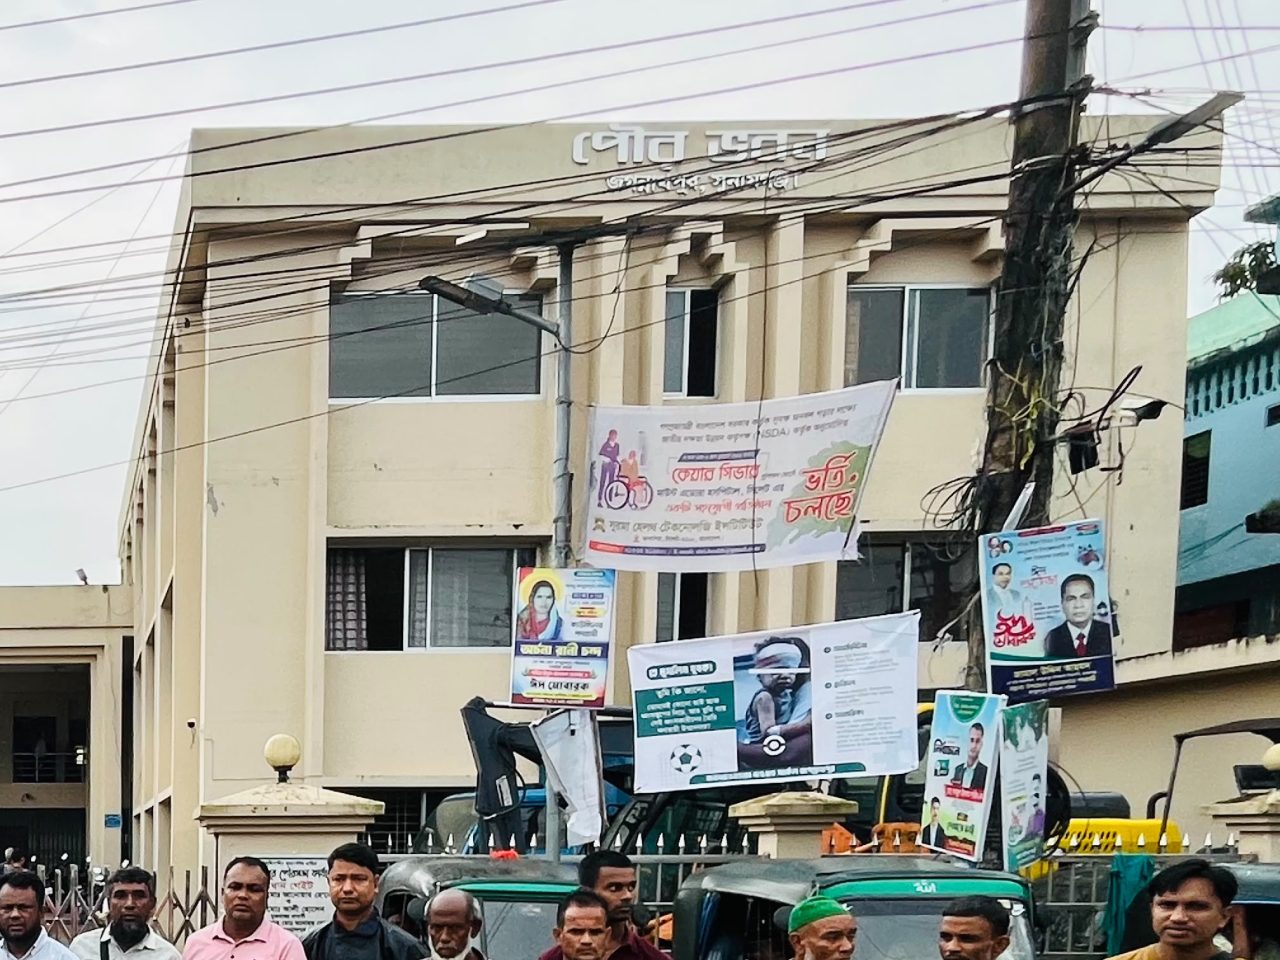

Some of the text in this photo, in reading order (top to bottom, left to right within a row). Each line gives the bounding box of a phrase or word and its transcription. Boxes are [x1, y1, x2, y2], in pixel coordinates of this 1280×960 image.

[572, 124, 832, 171] পৌর ভবন
[672, 467, 716, 484] কেয়ার
[802, 451, 856, 491] ভর্তি
[783, 489, 854, 523] চলছে
[547, 680, 590, 691] মোবারক
